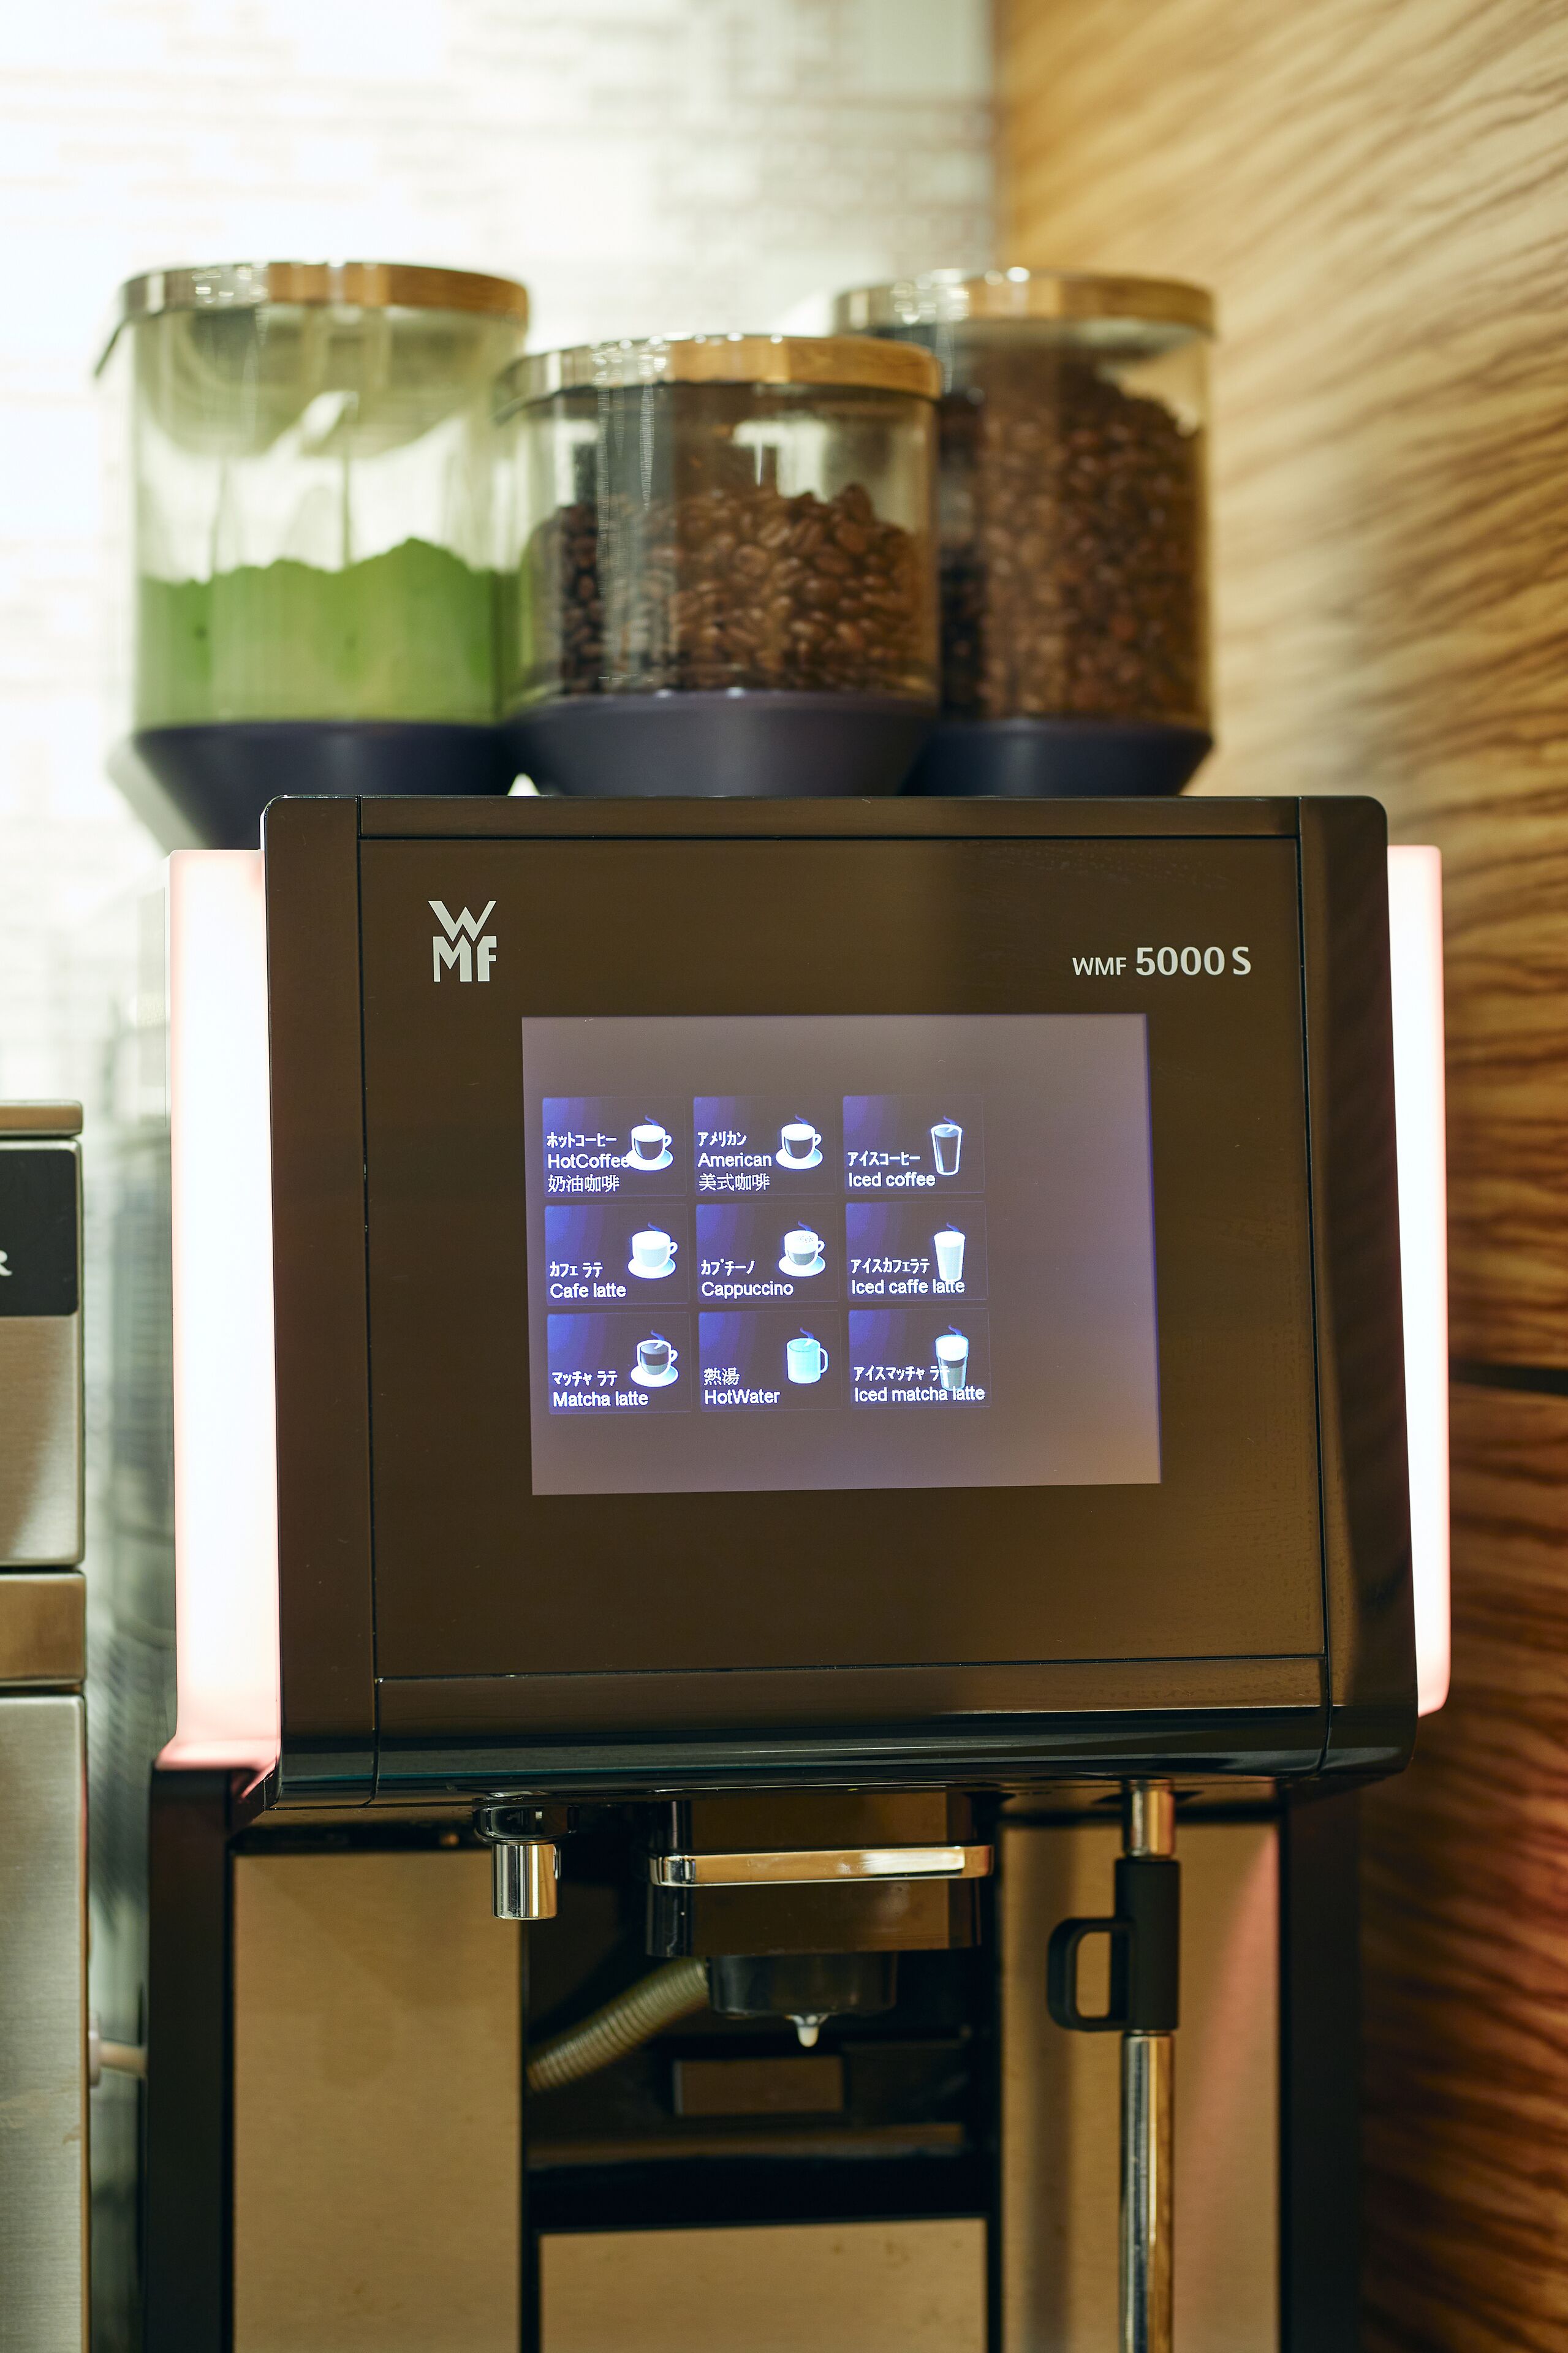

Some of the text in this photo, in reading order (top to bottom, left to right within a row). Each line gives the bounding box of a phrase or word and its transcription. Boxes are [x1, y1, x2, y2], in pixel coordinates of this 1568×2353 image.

[428, 900, 497, 982] WMF
[1072, 957, 1127, 976] WMF
[547, 1131, 617, 1148] ホットコーヒー
[697, 1130, 747, 1147] アメリカン
[548, 1153, 630, 1169] HotCoffee
[697, 1152, 772, 1167] American
[847, 1151, 921, 1167] アイスコーヒー
[547, 1173, 620, 1192] 奶油咖啡
[699, 1172, 770, 1191] 美式咖啡
[849, 1172, 936, 1187] Iced coffee
[550, 1261, 603, 1278] カフェ ラテ
[850, 1257, 930, 1274] アイスカフェラテ
[550, 1283, 627, 1298] Cafe latte
[701, 1281, 794, 1299] Cappuccino
[852, 1279, 966, 1294] Iced caffe latte
[551, 1370, 618, 1387] マッチャ ラテ
[703, 1367, 740, 1386] 熱湯
[854, 1365, 925, 1382] アイスマッチャ
[553, 1390, 649, 1407] Matcha latte
[705, 1389, 781, 1404] HotWater
[855, 1385, 985, 1402] Iced matcha latte
